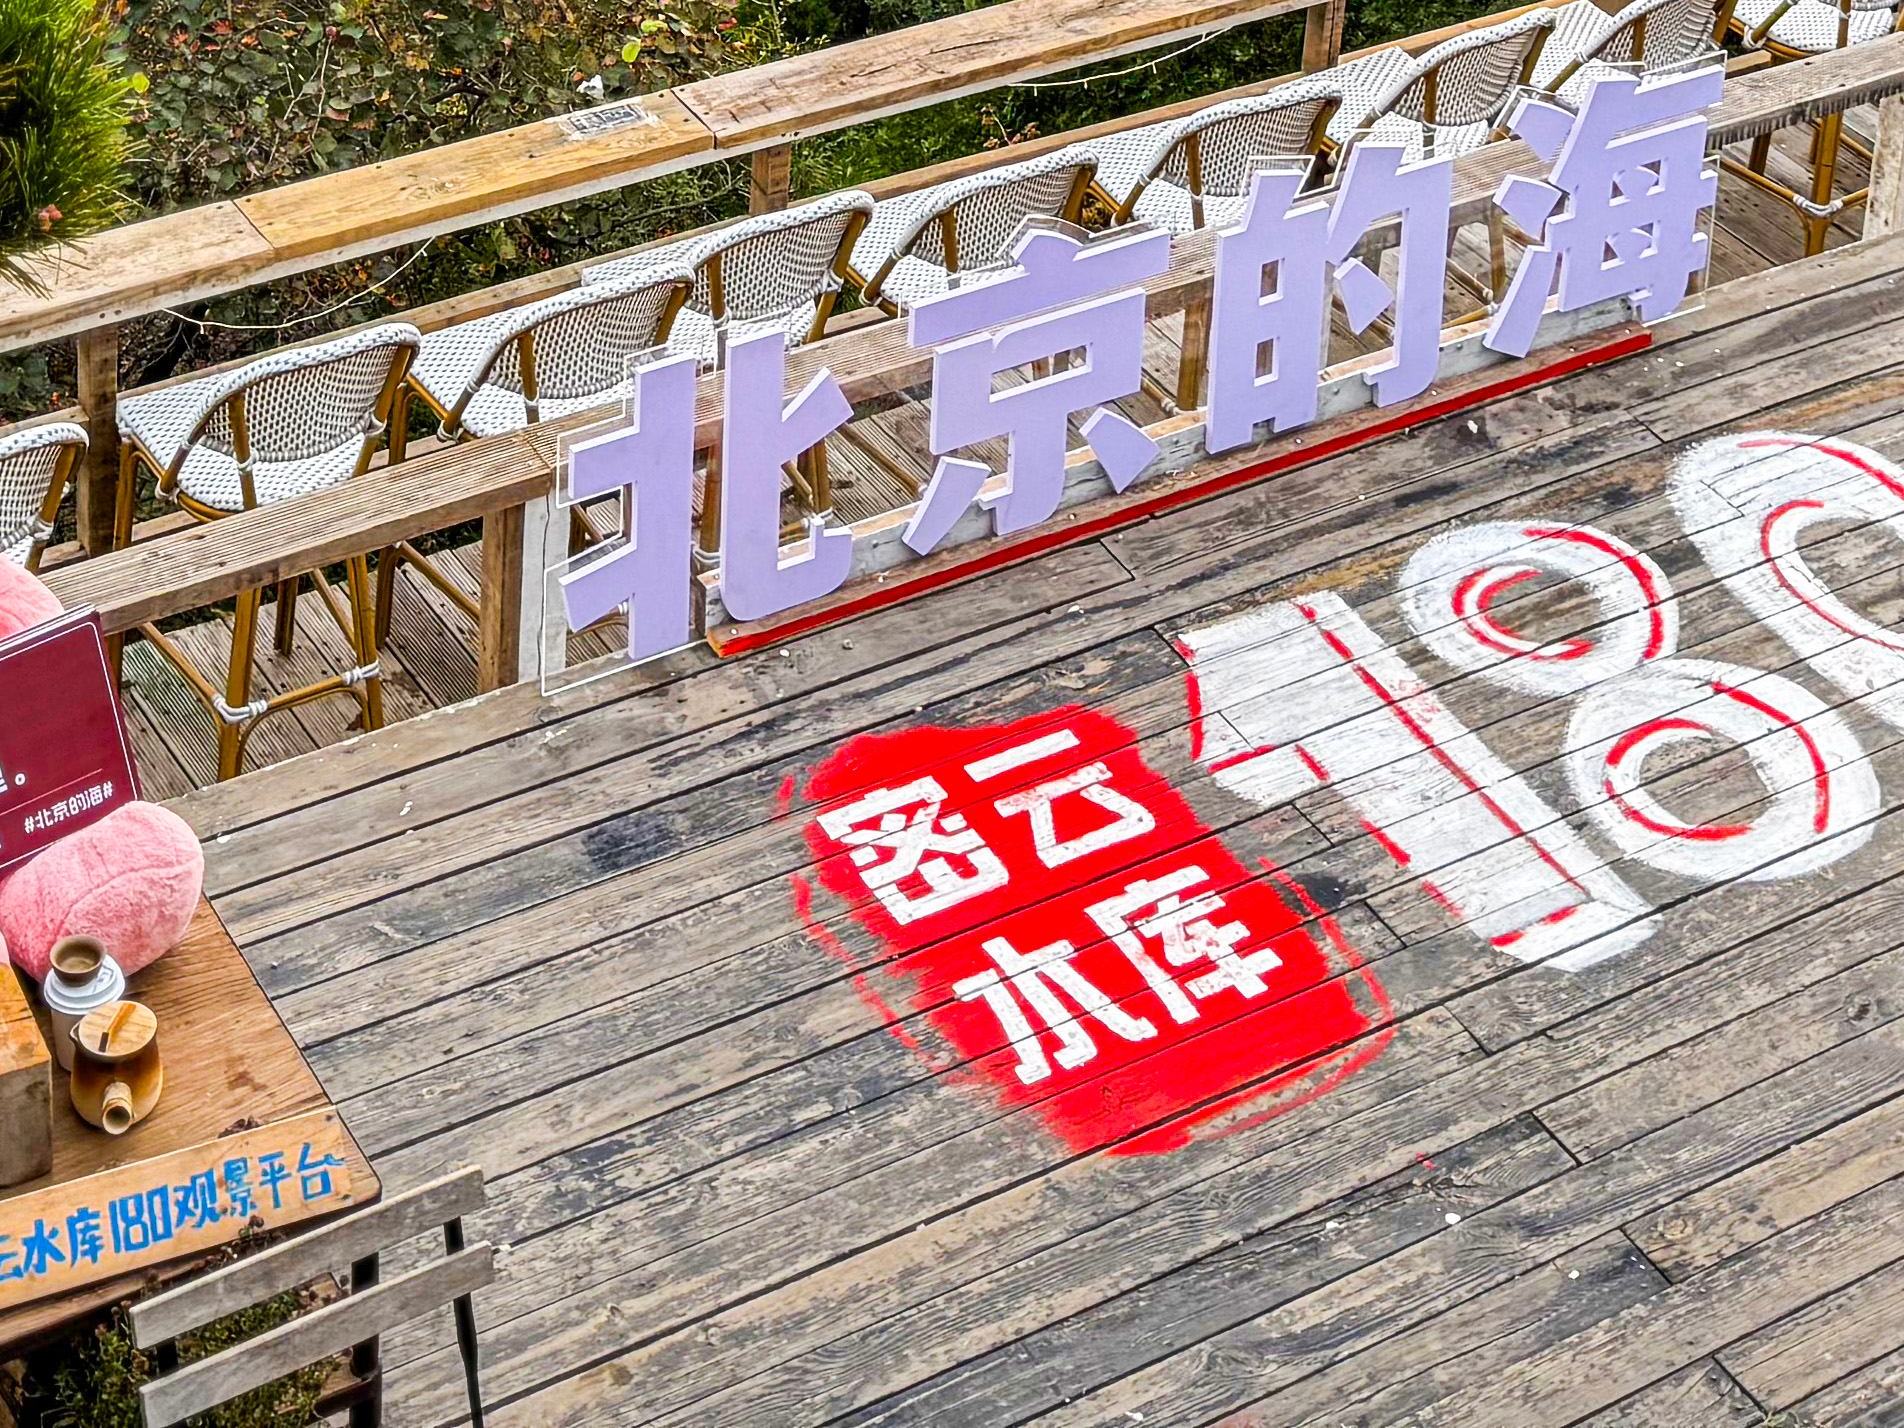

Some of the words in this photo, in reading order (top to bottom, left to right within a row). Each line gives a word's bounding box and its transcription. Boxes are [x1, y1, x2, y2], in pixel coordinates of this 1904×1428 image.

[558, 60, 1726, 661] 北京的海
[815, 728, 1157, 925] 密云
[954, 864, 1286, 1086] 水库
